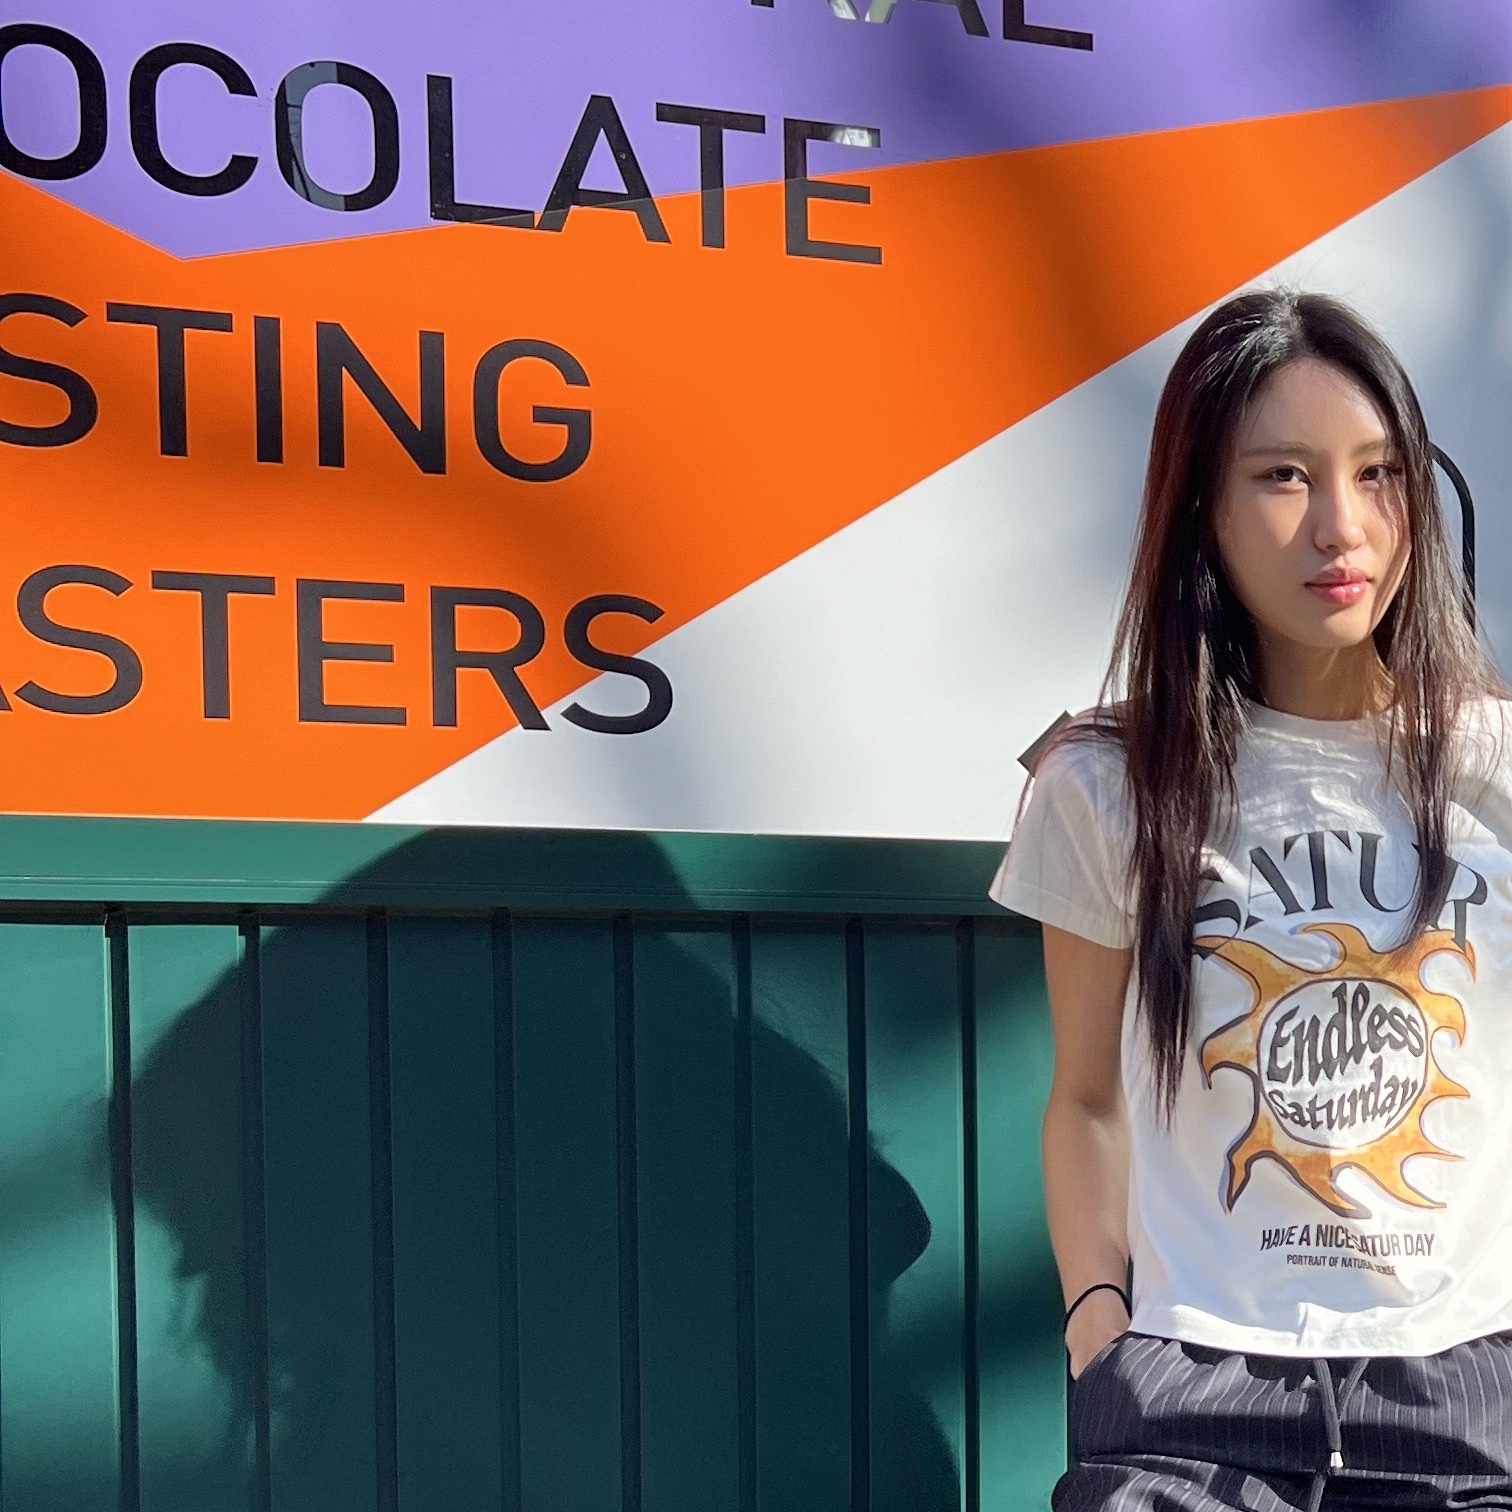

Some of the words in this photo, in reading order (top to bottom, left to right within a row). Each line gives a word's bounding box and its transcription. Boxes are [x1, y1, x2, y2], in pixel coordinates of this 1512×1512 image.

[0, 23, 882, 264] OCOLATE
[0, 292, 593, 482] STING
[0, 564, 674, 735] STERS
[1266, 981, 1424, 1087] Endless
[1268, 1055, 1418, 1131] Saturday
[1260, 1225, 1299, 1251] HAVE
[1298, 1224, 1311, 1246] A
[1403, 1233, 1435, 1257] DAY
[1286, 1254, 1327, 1267] PORTRAIT
[1328, 1256, 1339, 1267] OF
[1341, 1256, 1376, 1272] NATURA
